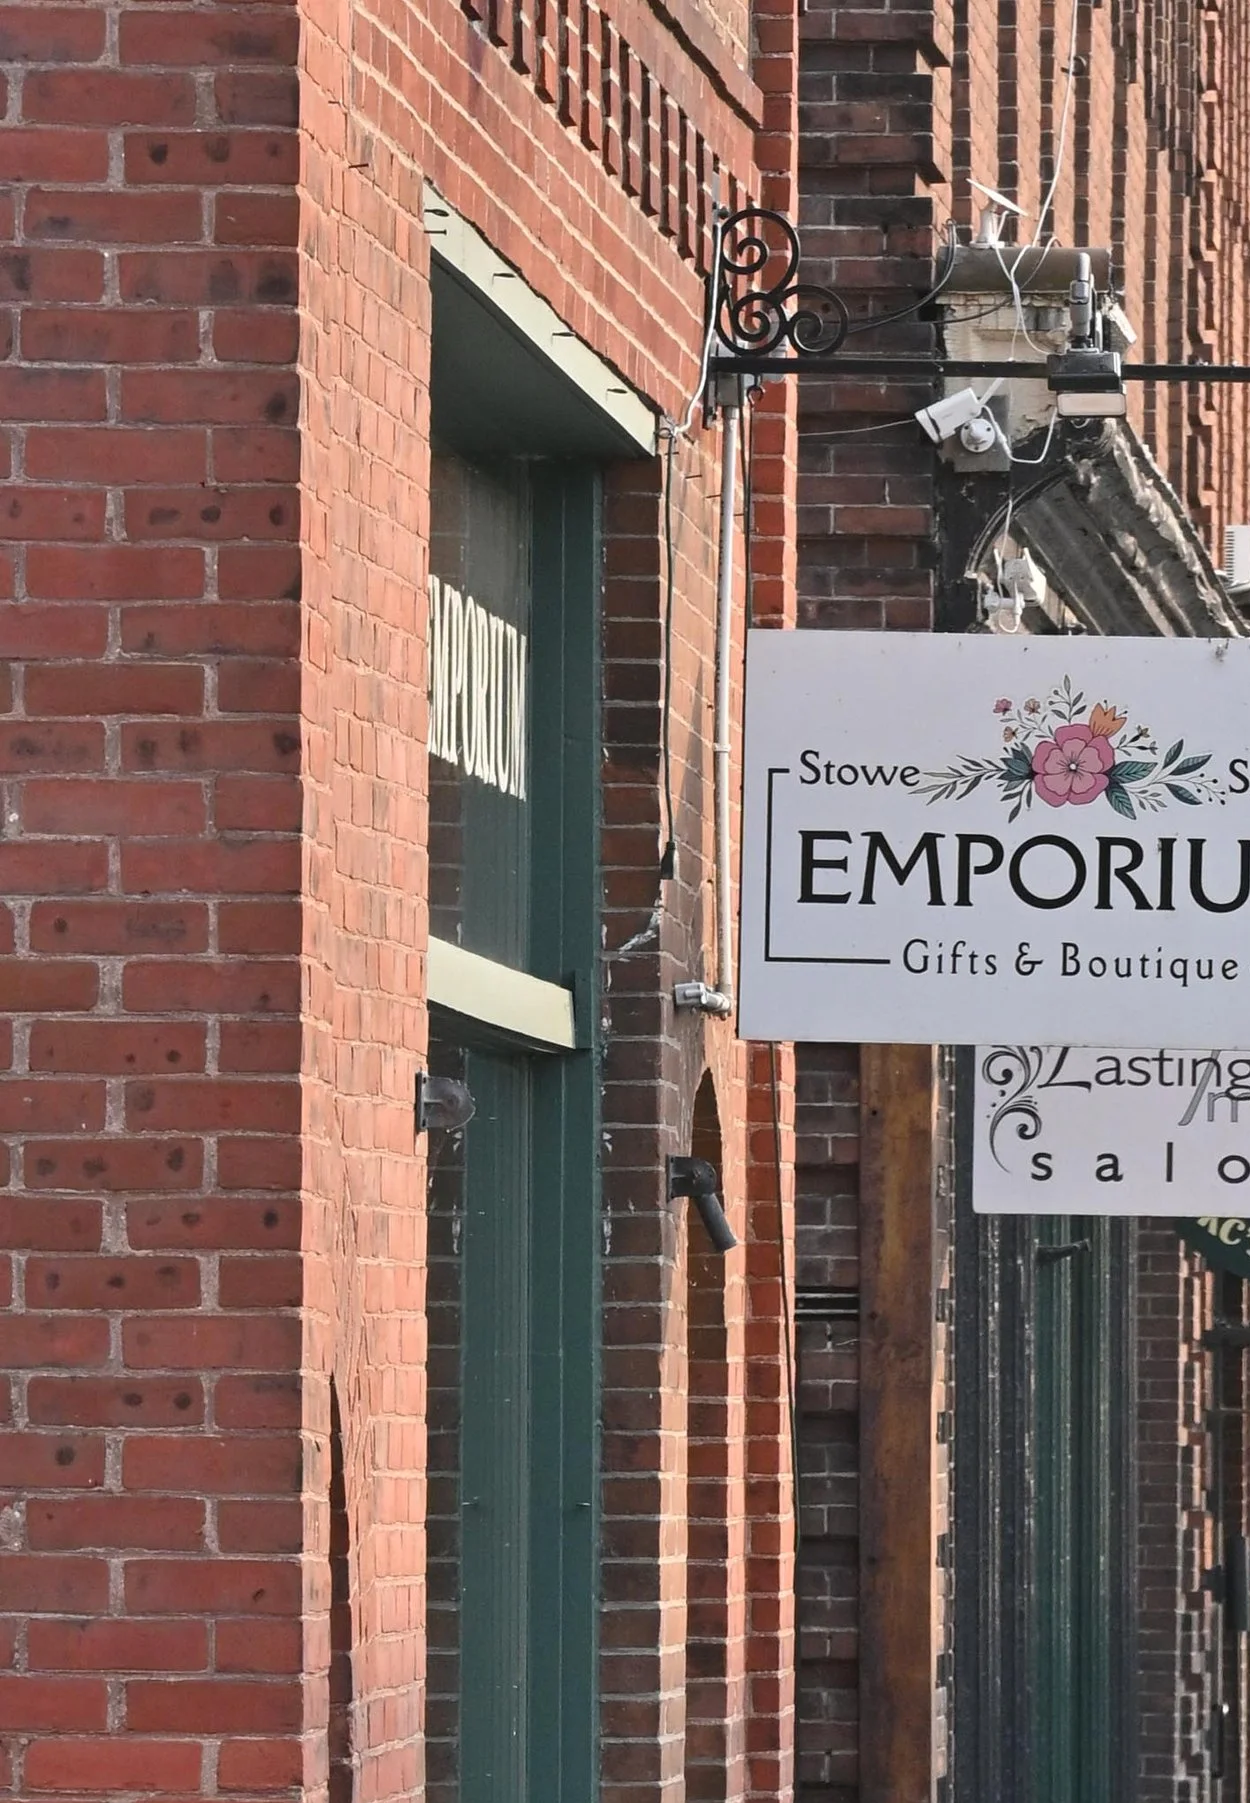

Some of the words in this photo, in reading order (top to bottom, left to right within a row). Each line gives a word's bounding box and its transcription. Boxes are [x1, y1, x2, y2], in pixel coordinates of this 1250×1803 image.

[798, 749, 921, 788] Stowe
[902, 938, 998, 978] Gifts
[1014, 942, 1044, 976] &
[1060, 942, 1239, 987] Boutique
